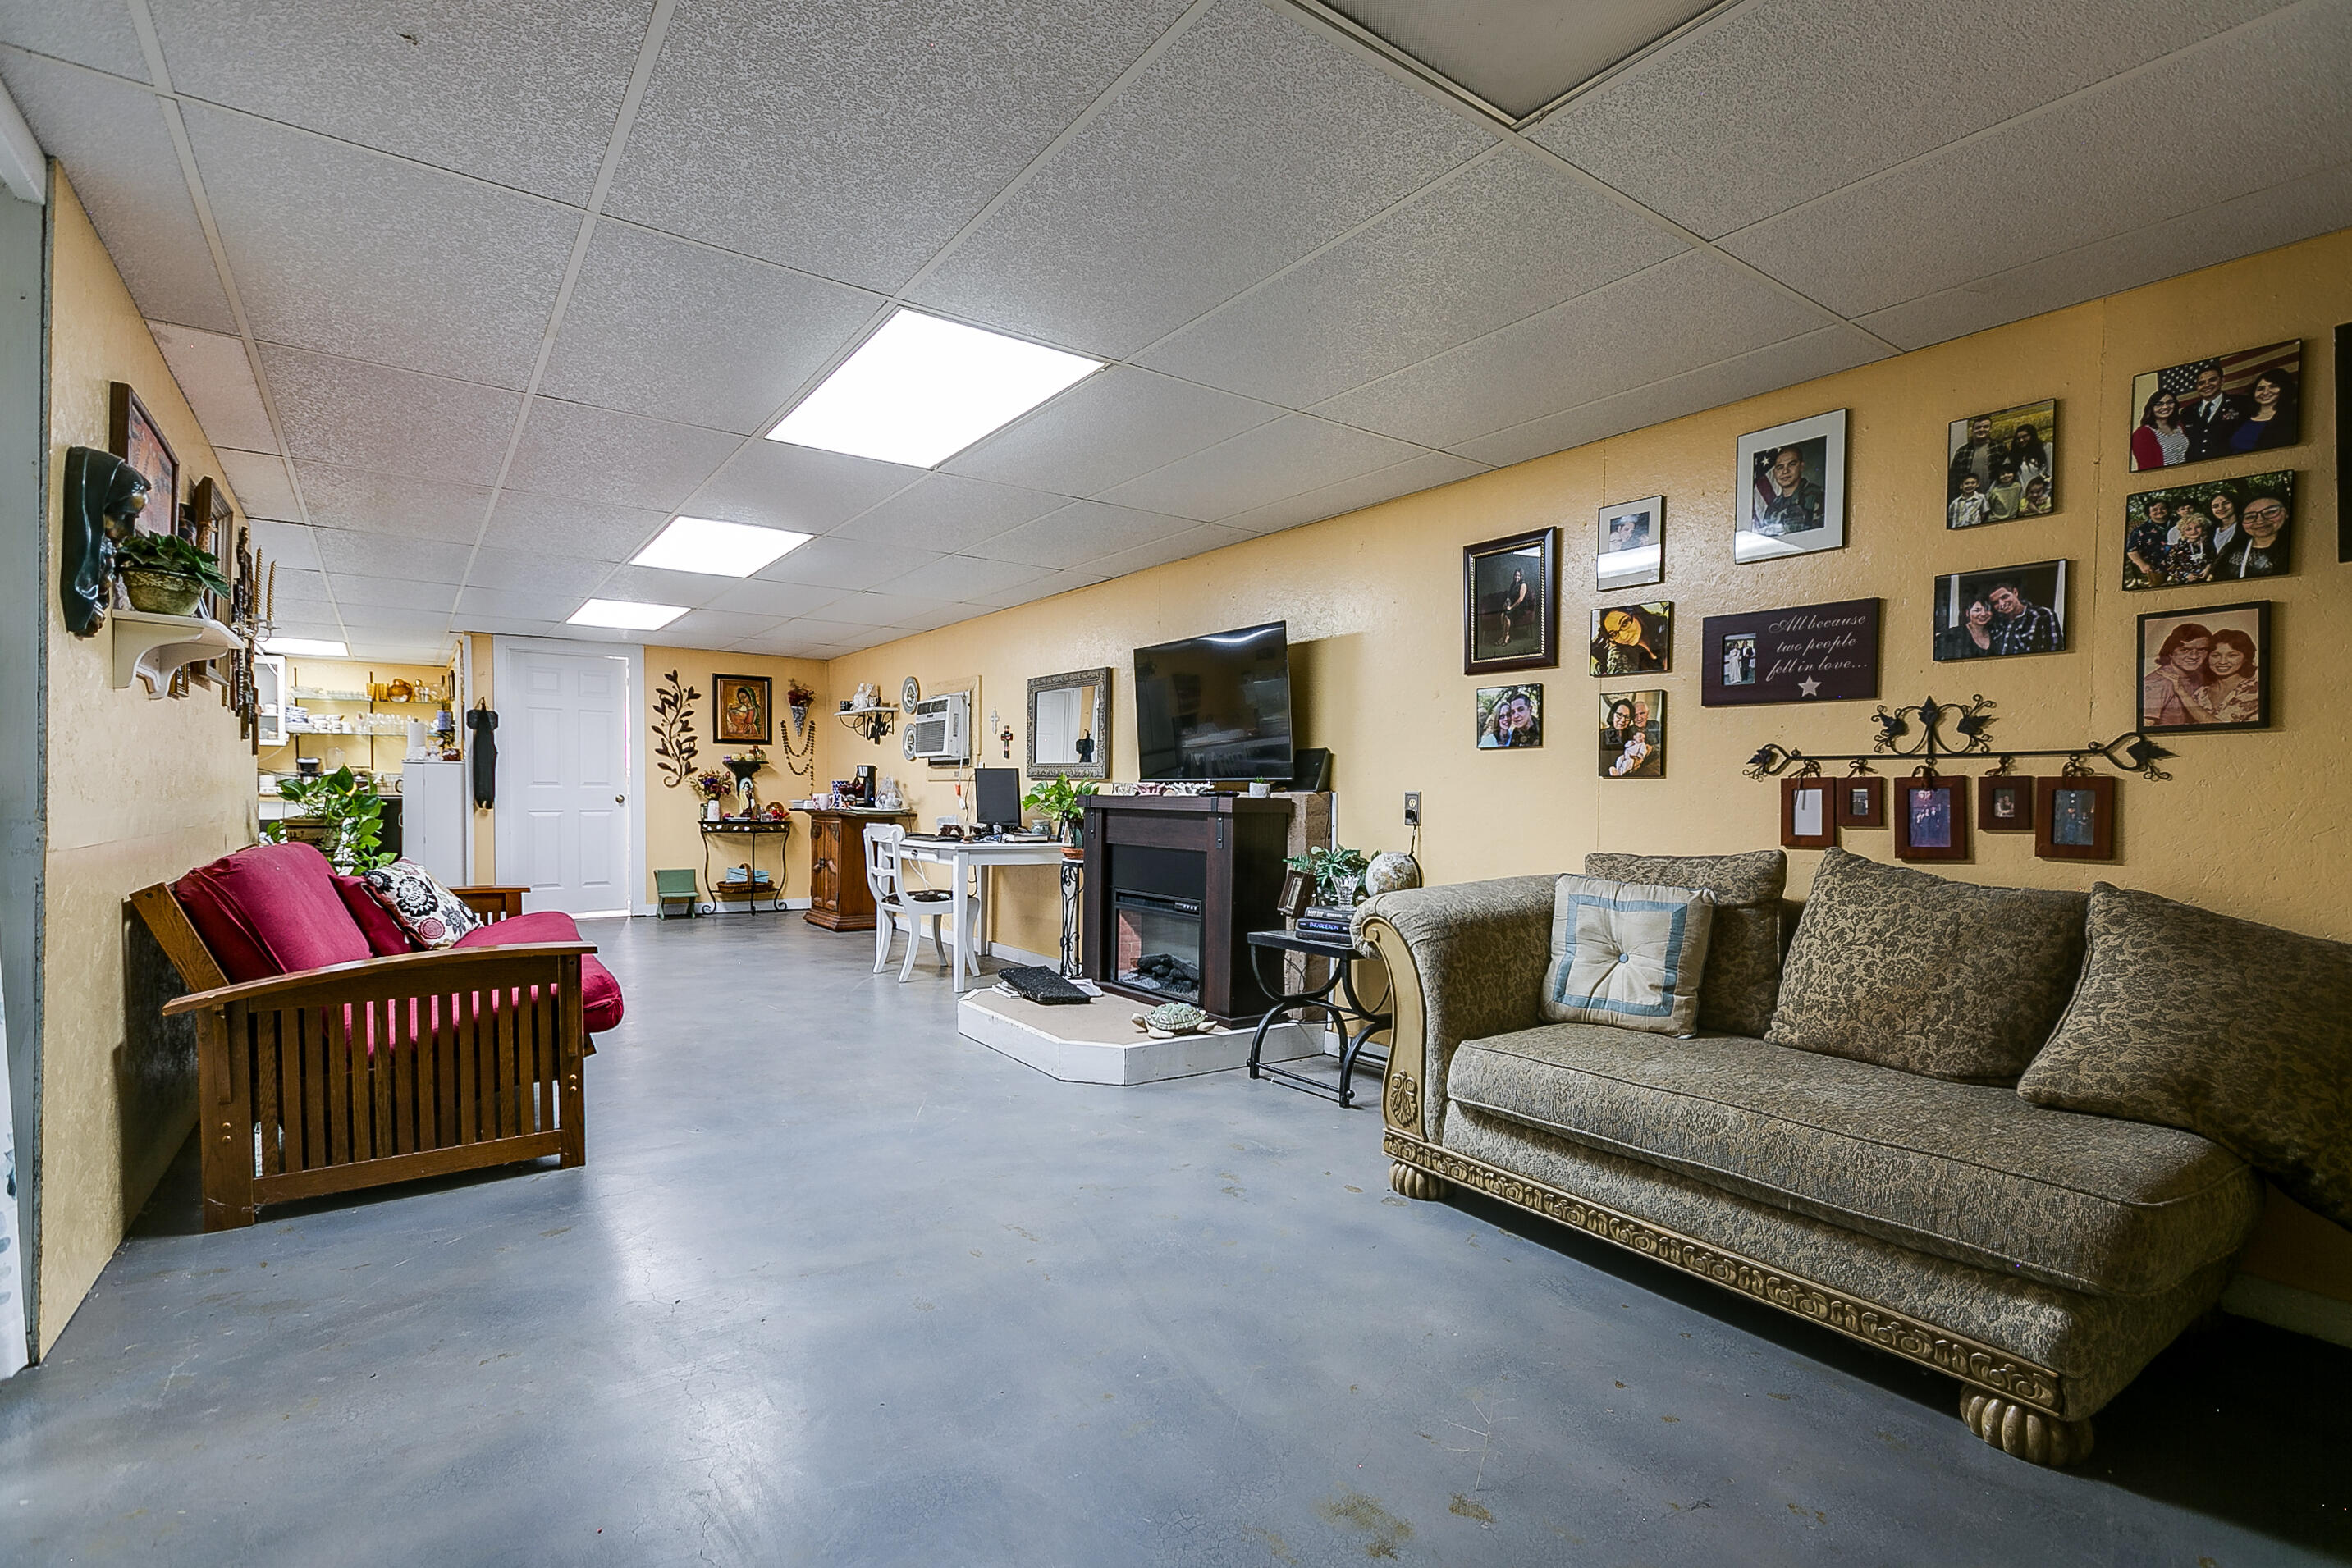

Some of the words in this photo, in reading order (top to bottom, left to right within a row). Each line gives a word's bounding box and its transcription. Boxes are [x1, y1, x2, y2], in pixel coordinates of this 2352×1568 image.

[1768, 615, 1808, 633] All
[1807, 615, 1866, 629] because
[1776, 641, 1802, 654] two
[1802, 631, 1856, 656] people
[1765, 658, 1797, 682] fell
[1797, 661, 1814, 672] in
[1818, 656, 1868, 671] love...
